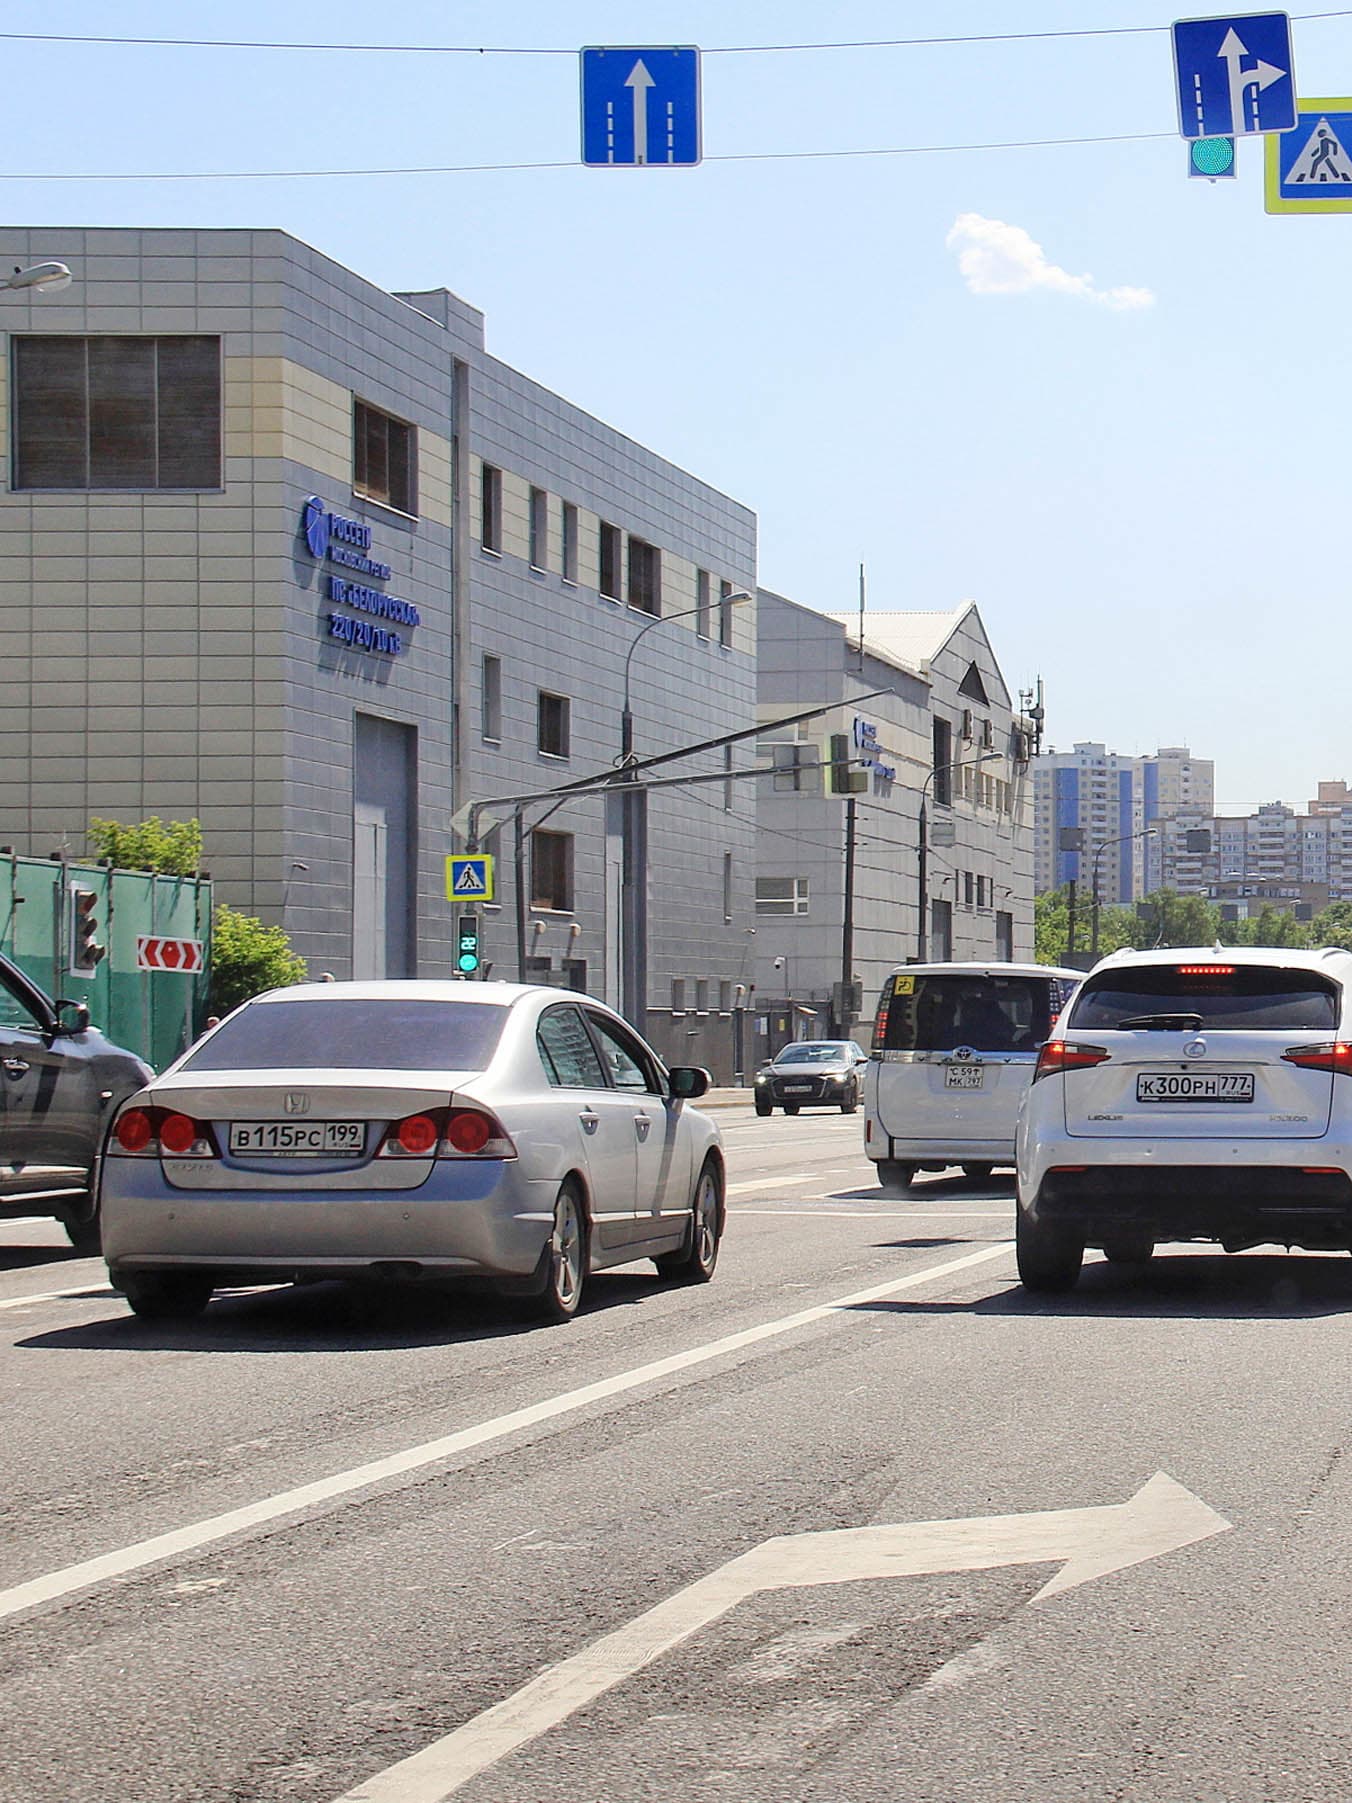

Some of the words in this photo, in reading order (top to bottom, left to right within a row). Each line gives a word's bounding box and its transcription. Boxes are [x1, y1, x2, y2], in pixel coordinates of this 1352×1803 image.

[1143, 1076, 1216, 1095] К300РН
[1221, 1076, 1248, 1090] 777
[238, 1126, 321, 1147] В115РС
[328, 1125, 358, 1141] 199
